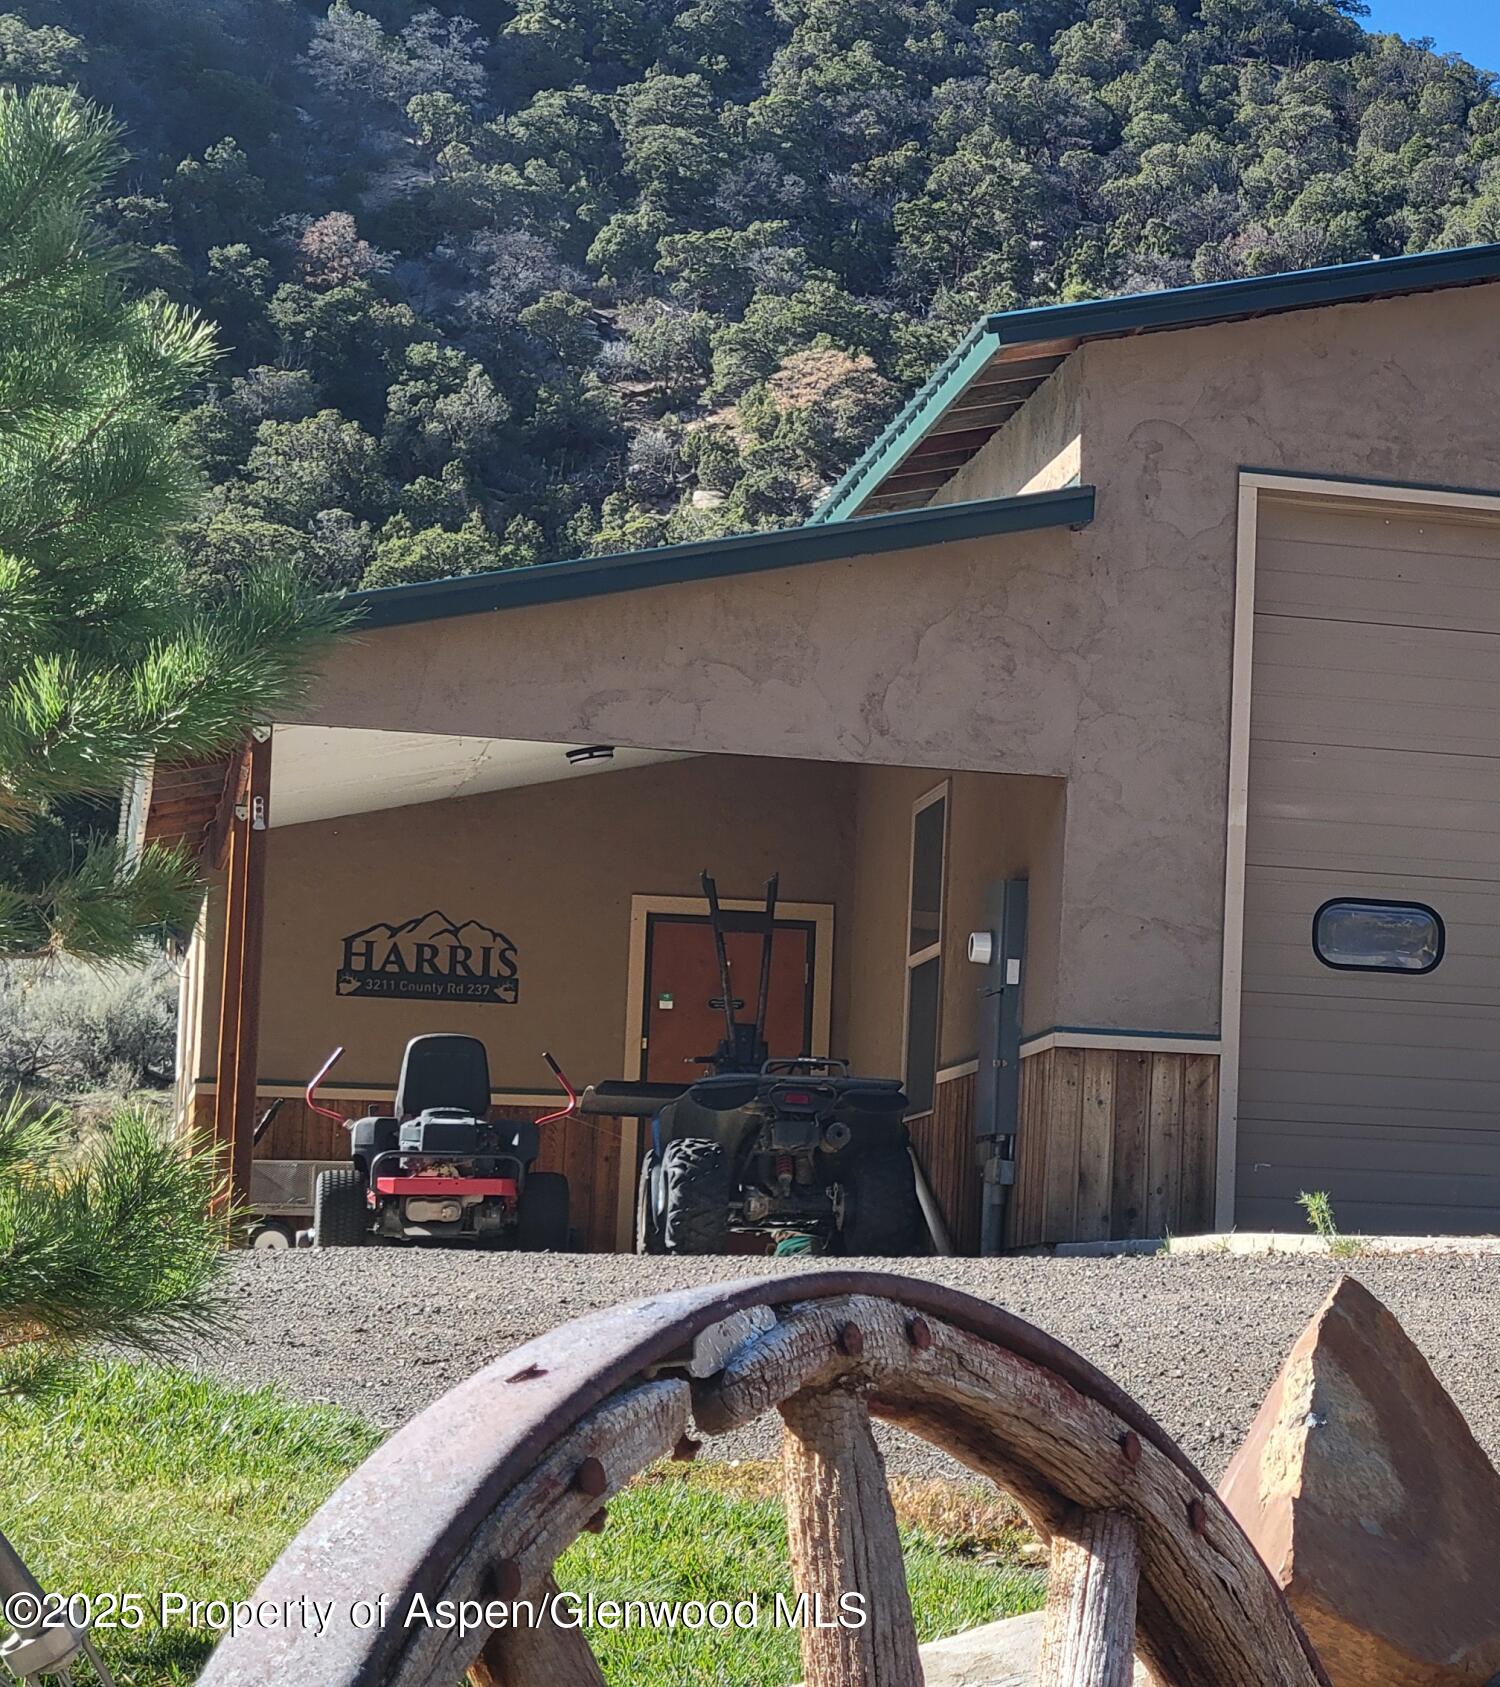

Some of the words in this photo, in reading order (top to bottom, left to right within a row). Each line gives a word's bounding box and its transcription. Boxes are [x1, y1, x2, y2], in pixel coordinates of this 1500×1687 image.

[341, 938, 519, 979] HARRIS
[365, 979, 395, 991] 3211
[399, 981, 444, 995] County
[447, 983, 464, 994] Rd
[467, 984, 490, 995] 237
